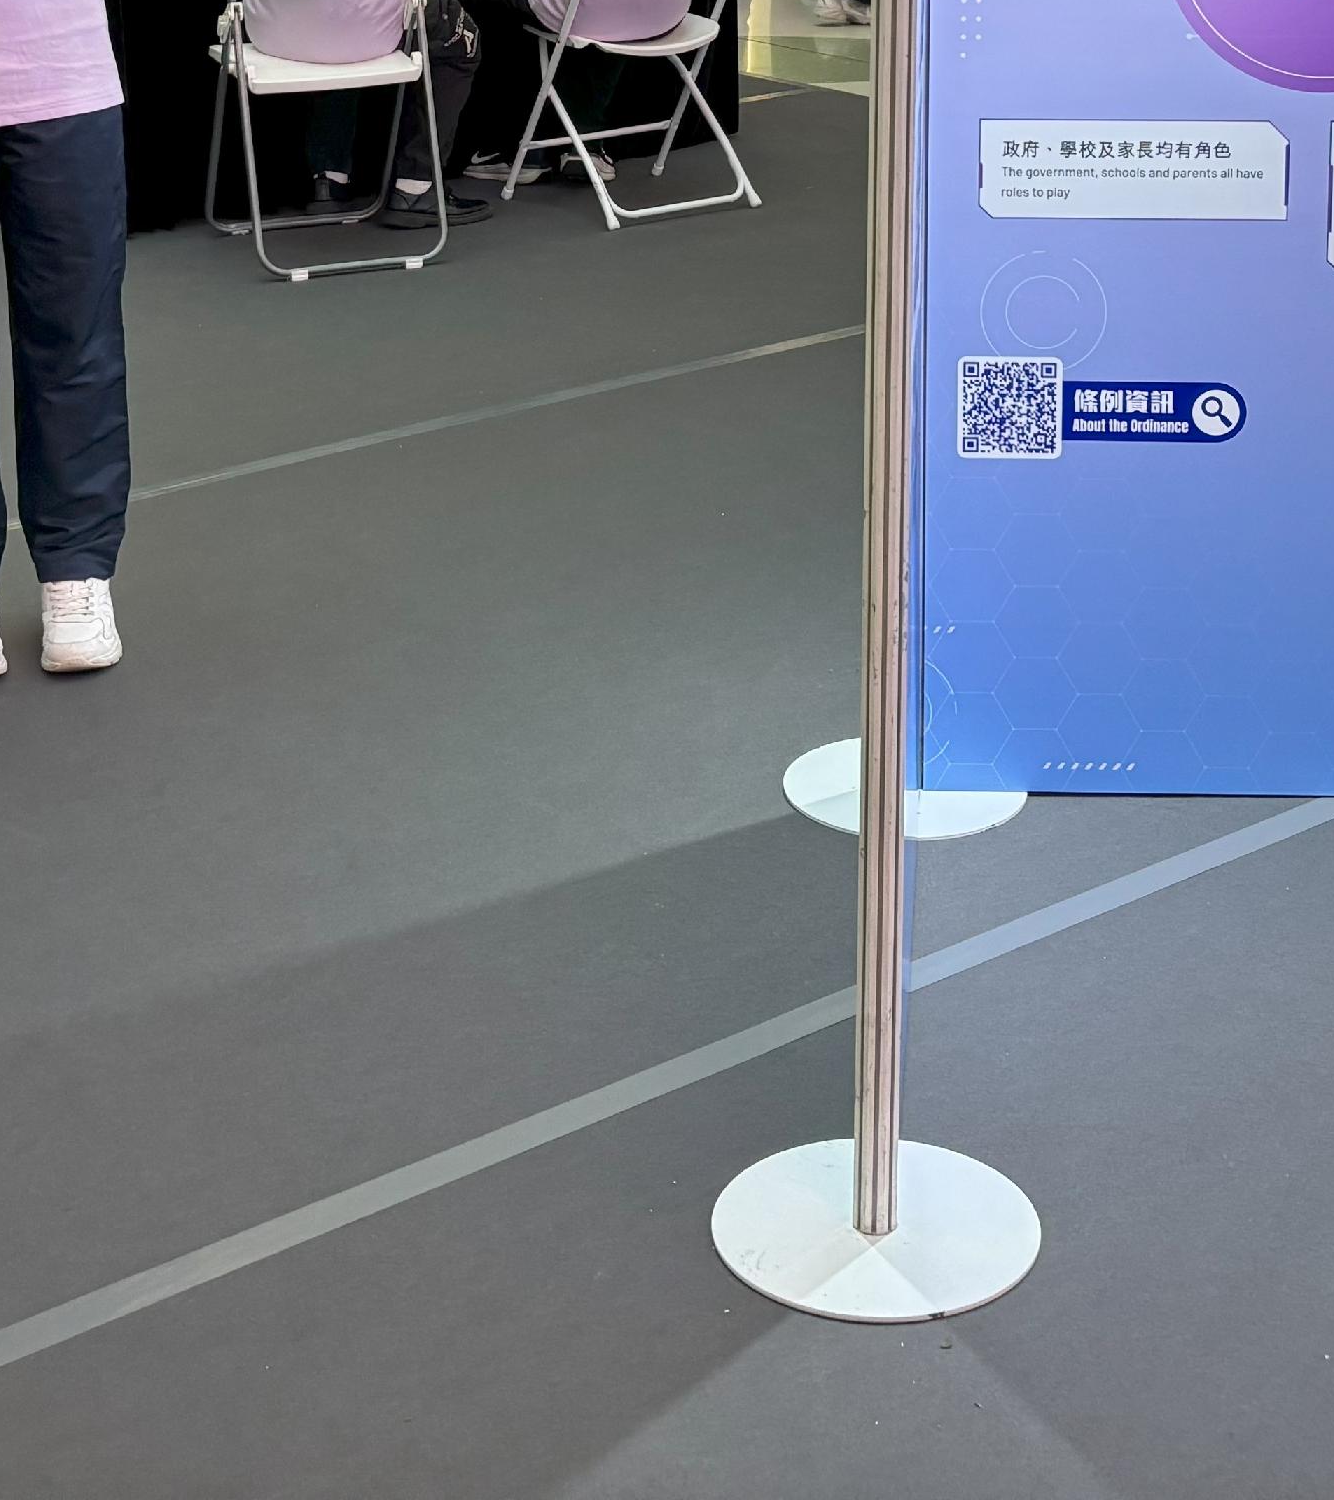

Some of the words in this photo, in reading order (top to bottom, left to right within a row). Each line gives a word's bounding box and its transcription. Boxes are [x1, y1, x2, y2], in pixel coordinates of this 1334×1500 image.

[1002, 140, 1232, 159] 政府、學校及家長均有角色
[1002, 167, 1023, 178] The
[1026, 167, 1099, 180] government,
[1101, 167, 1146, 179] schools
[1149, 168, 1170, 179] and
[1172, 168, 1218, 181] parents
[1220, 168, 1233, 179] all
[1236, 168, 1264, 180] have
[1001, 187, 1029, 198] roles
[1032, 187, 1044, 198] to
[1046, 187, 1070, 200] play
[1074, 389, 1175, 414] 條例資訊
[1072, 418, 1106, 433] About
[1108, 419, 1128, 433] the
[1130, 419, 1189, 434] Ordinance
